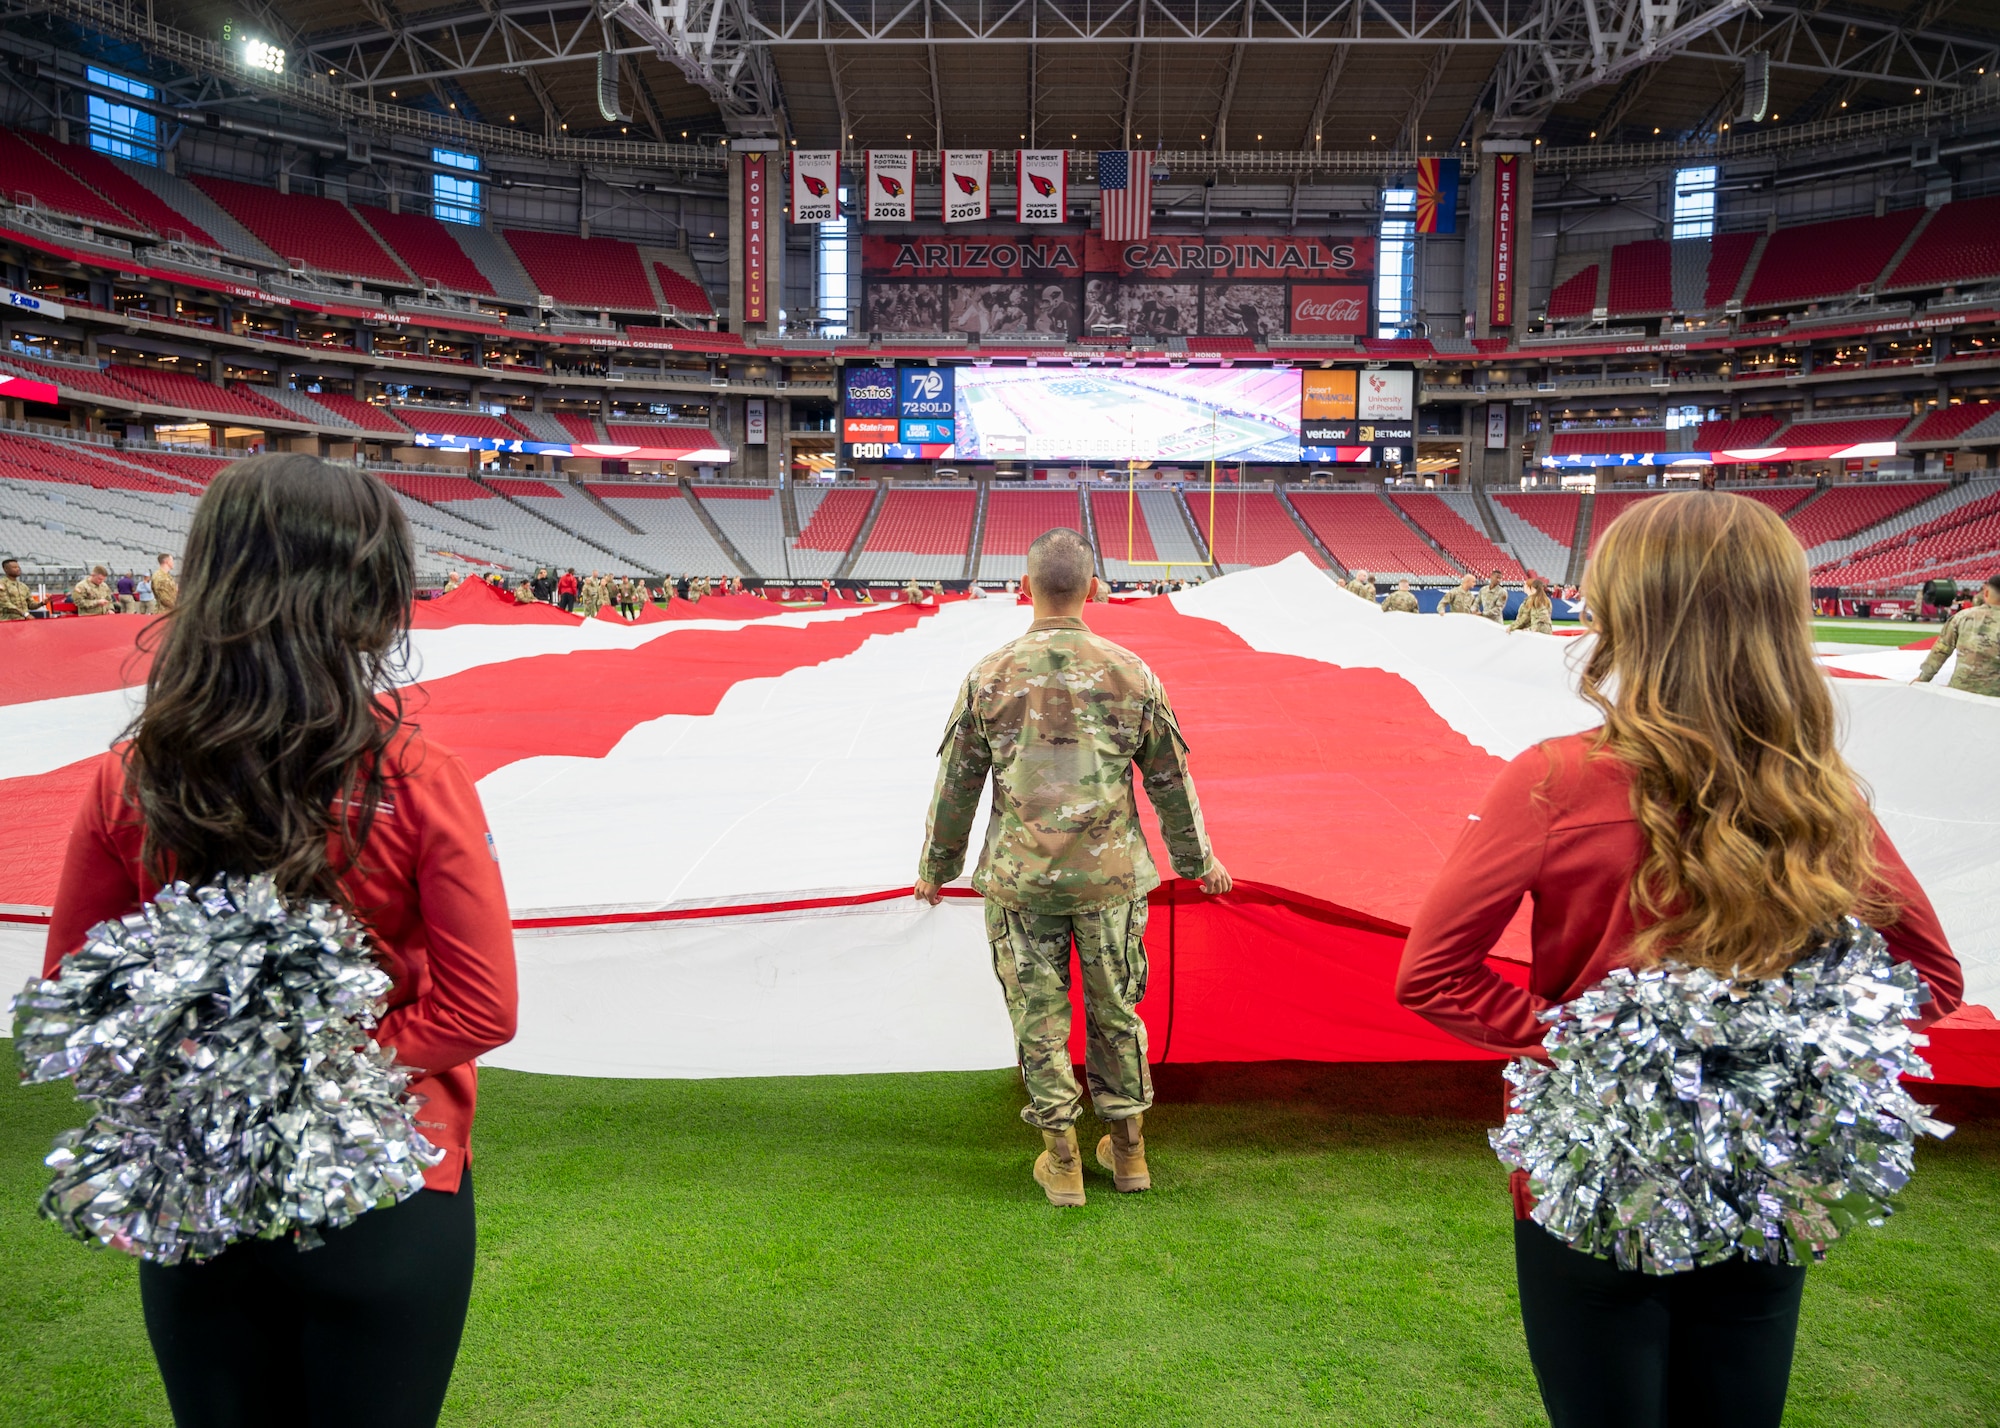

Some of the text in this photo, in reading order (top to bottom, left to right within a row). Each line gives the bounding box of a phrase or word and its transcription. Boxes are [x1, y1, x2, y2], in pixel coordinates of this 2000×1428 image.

[800, 210, 832, 220] 2008
[874, 208, 906, 218] 2008
[950, 206, 981, 218] 2009
[1026, 209, 1058, 218] 2015
[750, 170, 760, 318] FOOTBALL CLUB
[1497, 172, 1510, 322] ESTABLISHED 1898
[892, 244, 1355, 270] ARIZONA CARDINALS
[235, 288, 257, 298] KURT
[258, 292, 292, 306] WARNER
[1295, 298, 1364, 322] Coca-Cola
[372, 312, 388, 321] JIM
[388, 314, 412, 324] HART
[1876, 322, 1915, 332] AENEAS
[1917, 316, 1966, 327] WILLIAMS
[589, 338, 632, 348] MARSHALL
[632, 341, 674, 350] GOLDBERG
[1651, 344, 1686, 352] MATSON
[1306, 386, 1332, 394] desert
[1306, 428, 1346, 439] verizon
[1374, 430, 1411, 439] BETMGM
[852, 443, 884, 458] 0:00
[1076, 440, 1150, 452] STUBBLEFELD
